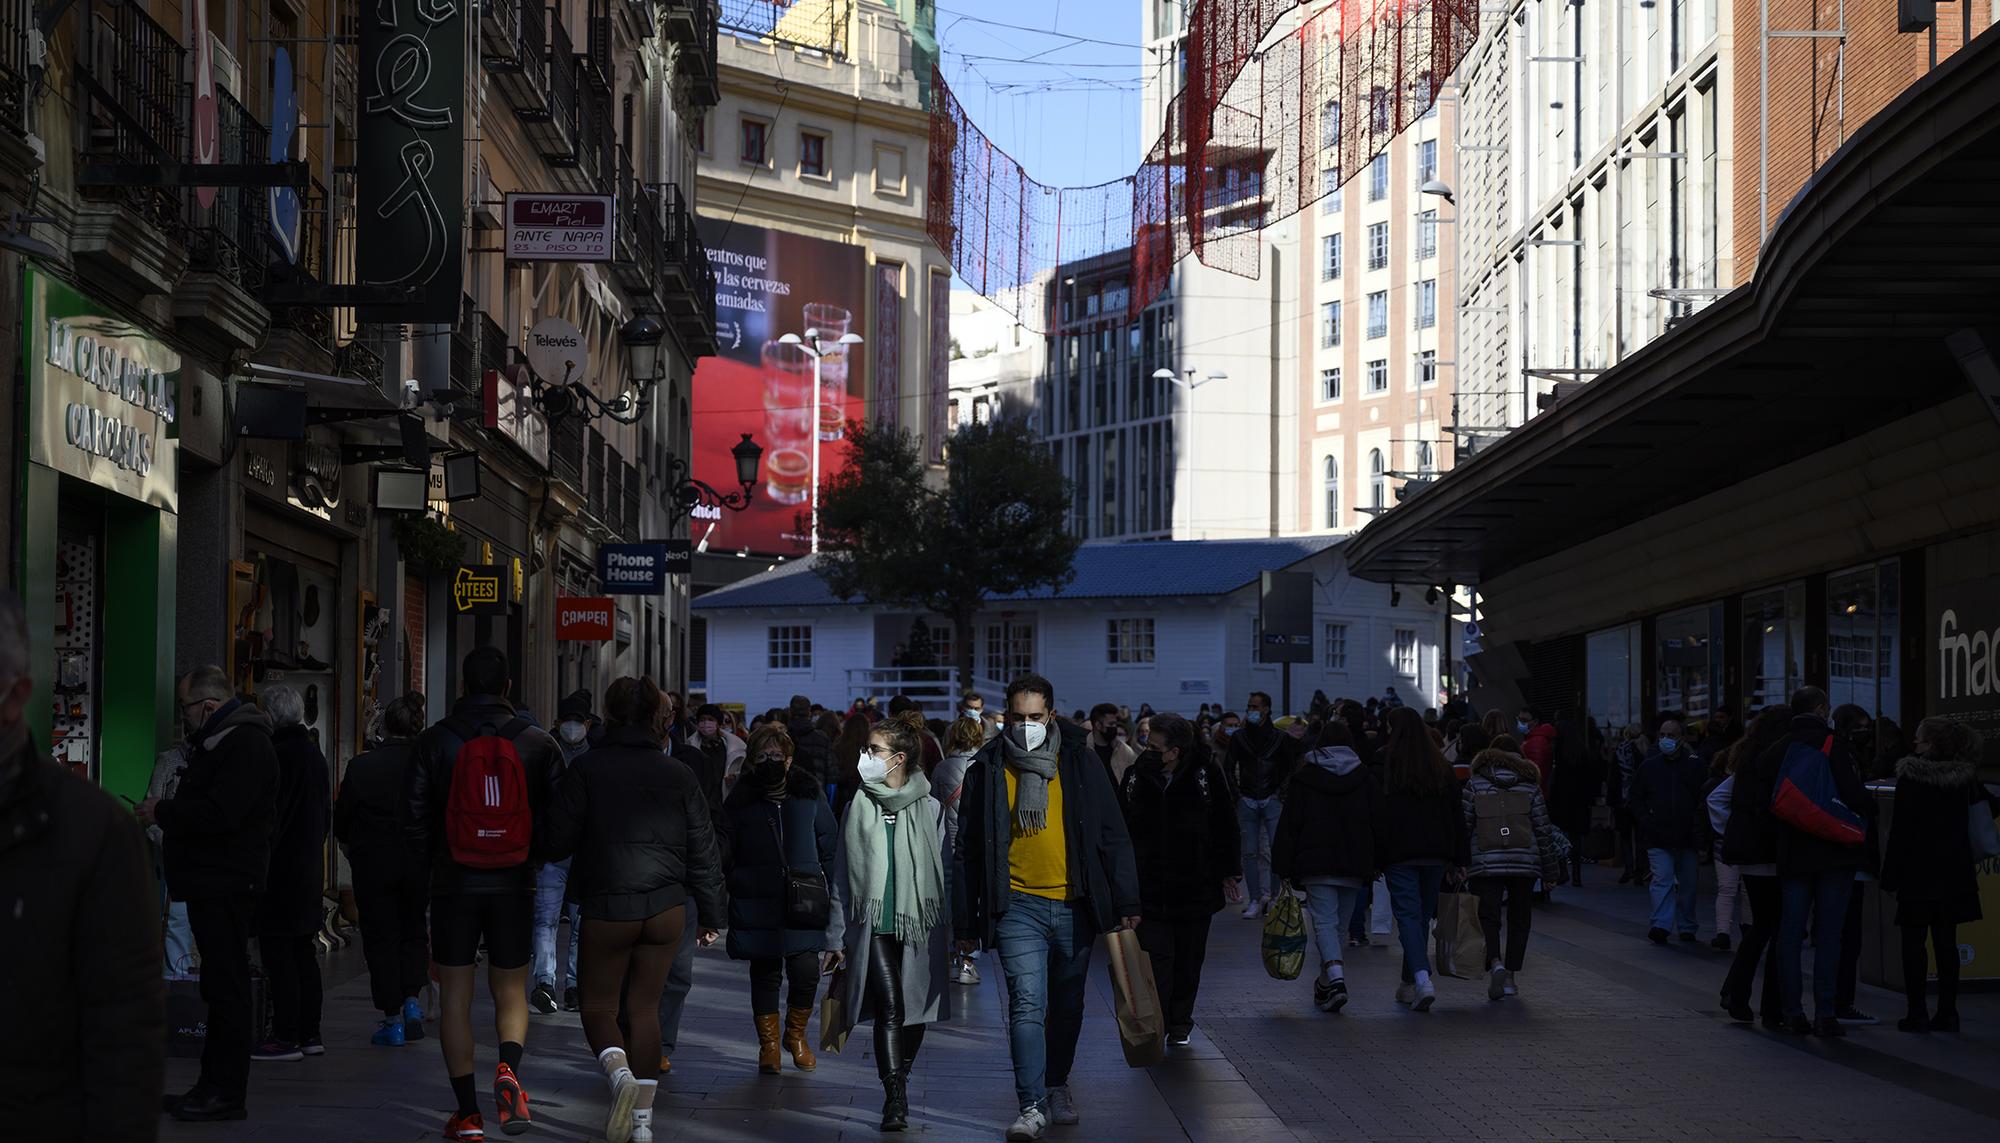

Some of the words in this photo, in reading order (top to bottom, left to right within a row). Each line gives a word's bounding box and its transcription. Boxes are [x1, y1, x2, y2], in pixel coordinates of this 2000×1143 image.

[514, 230, 552, 242] ANTE
[563, 231, 604, 243] NAPA
[745, 255, 767, 273] que
[723, 266, 740, 287] las
[741, 276, 791, 296] cervezas
[46, 318, 75, 373] LA
[533, 334, 577, 347] Televés
[607, 552, 655, 567] Phone
[607, 568, 654, 581] House
[454, 582, 494, 597] CITEES
[561, 610, 608, 627] CAMPER
